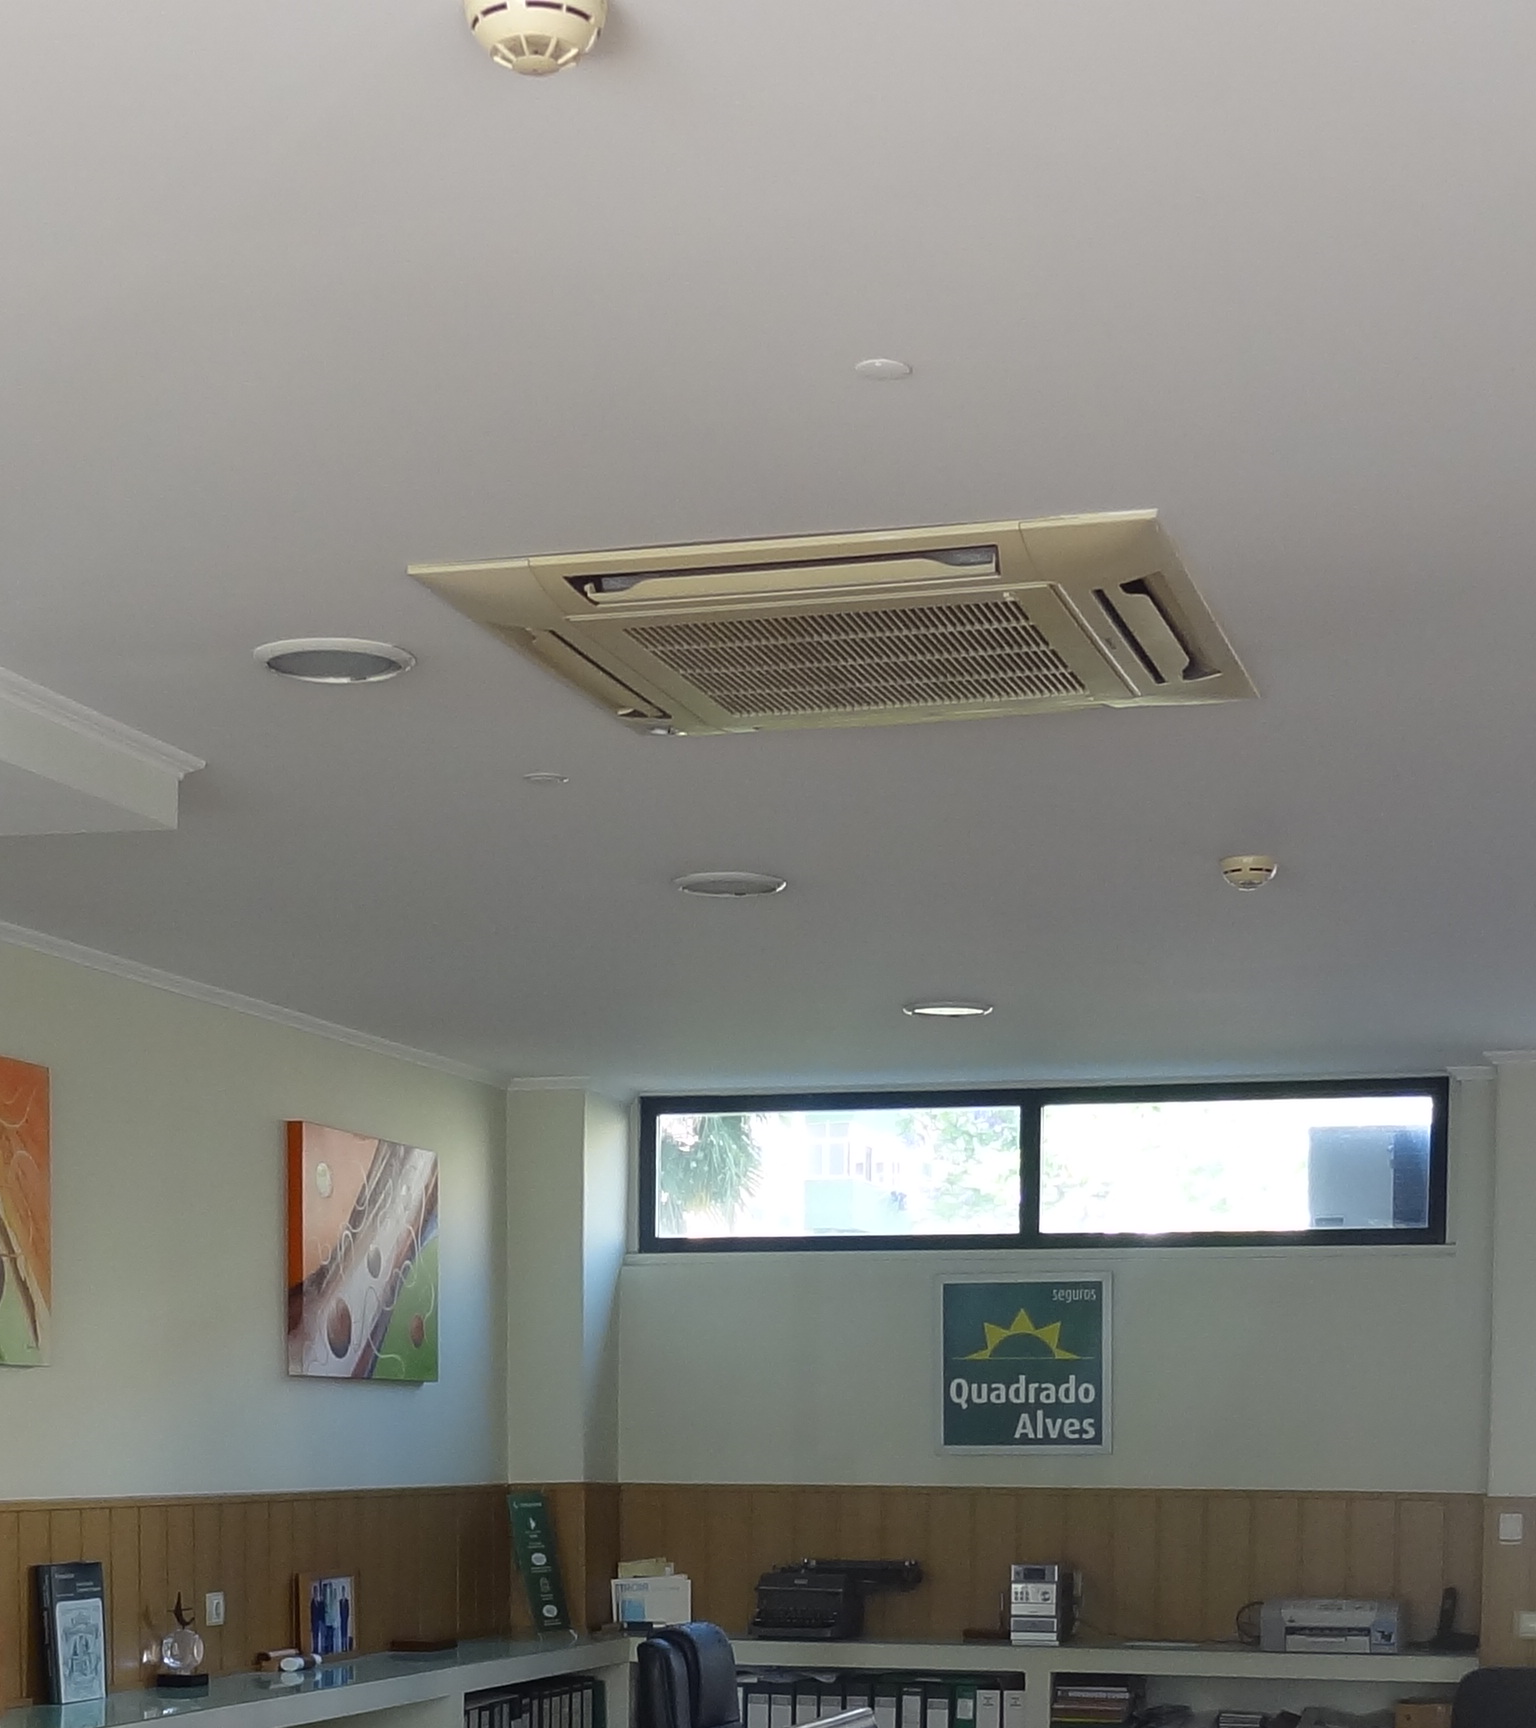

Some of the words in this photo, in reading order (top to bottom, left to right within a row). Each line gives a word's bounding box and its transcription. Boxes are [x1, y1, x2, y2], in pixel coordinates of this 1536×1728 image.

[1052, 1288, 1097, 1304] seguros
[949, 1374, 1096, 1410] Quadrado
[1014, 1409, 1096, 1440] Alves
